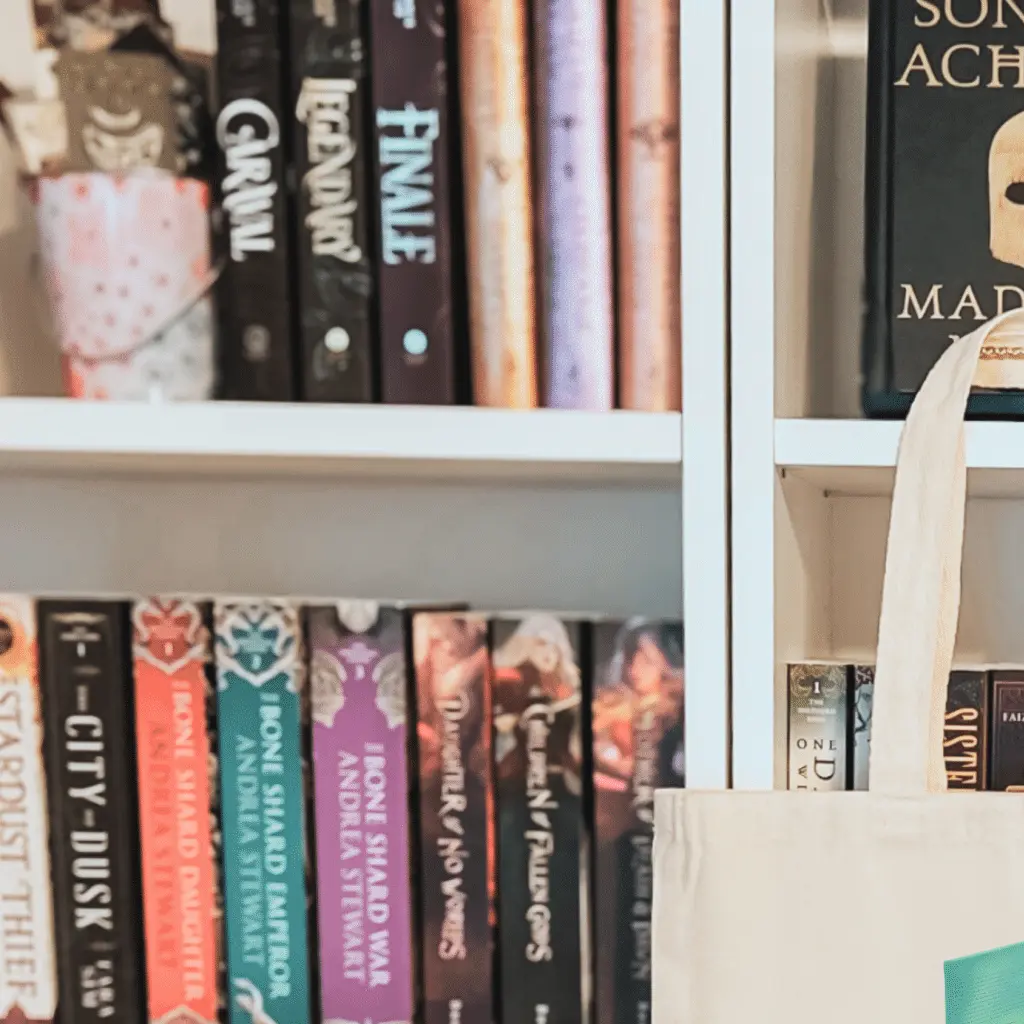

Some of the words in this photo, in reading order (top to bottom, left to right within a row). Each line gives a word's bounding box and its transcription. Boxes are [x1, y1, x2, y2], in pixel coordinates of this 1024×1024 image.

[376, 102, 440, 265] FINALE
[65, 714, 107, 806] CITY
[260, 705, 285, 775] BONE
[796, 739, 837, 751] ONE
[944, 707, 978, 791] SISTE
[235, 734, 261, 844] ANDREA
[264, 783, 288, 874] SHARD
[337, 750, 363, 860] ANDREA
[364, 755, 388, 826] BONE
[69, 830, 113, 931] DUSK
[240, 850, 265, 966] STEWART
[341, 866, 366, 982] STEWART
[365, 834, 390, 924] SHARD
[6, 881, 39, 1001] THIEF
[267, 882, 291, 999] EMPEROR
[367, 930, 392, 988] WAR
